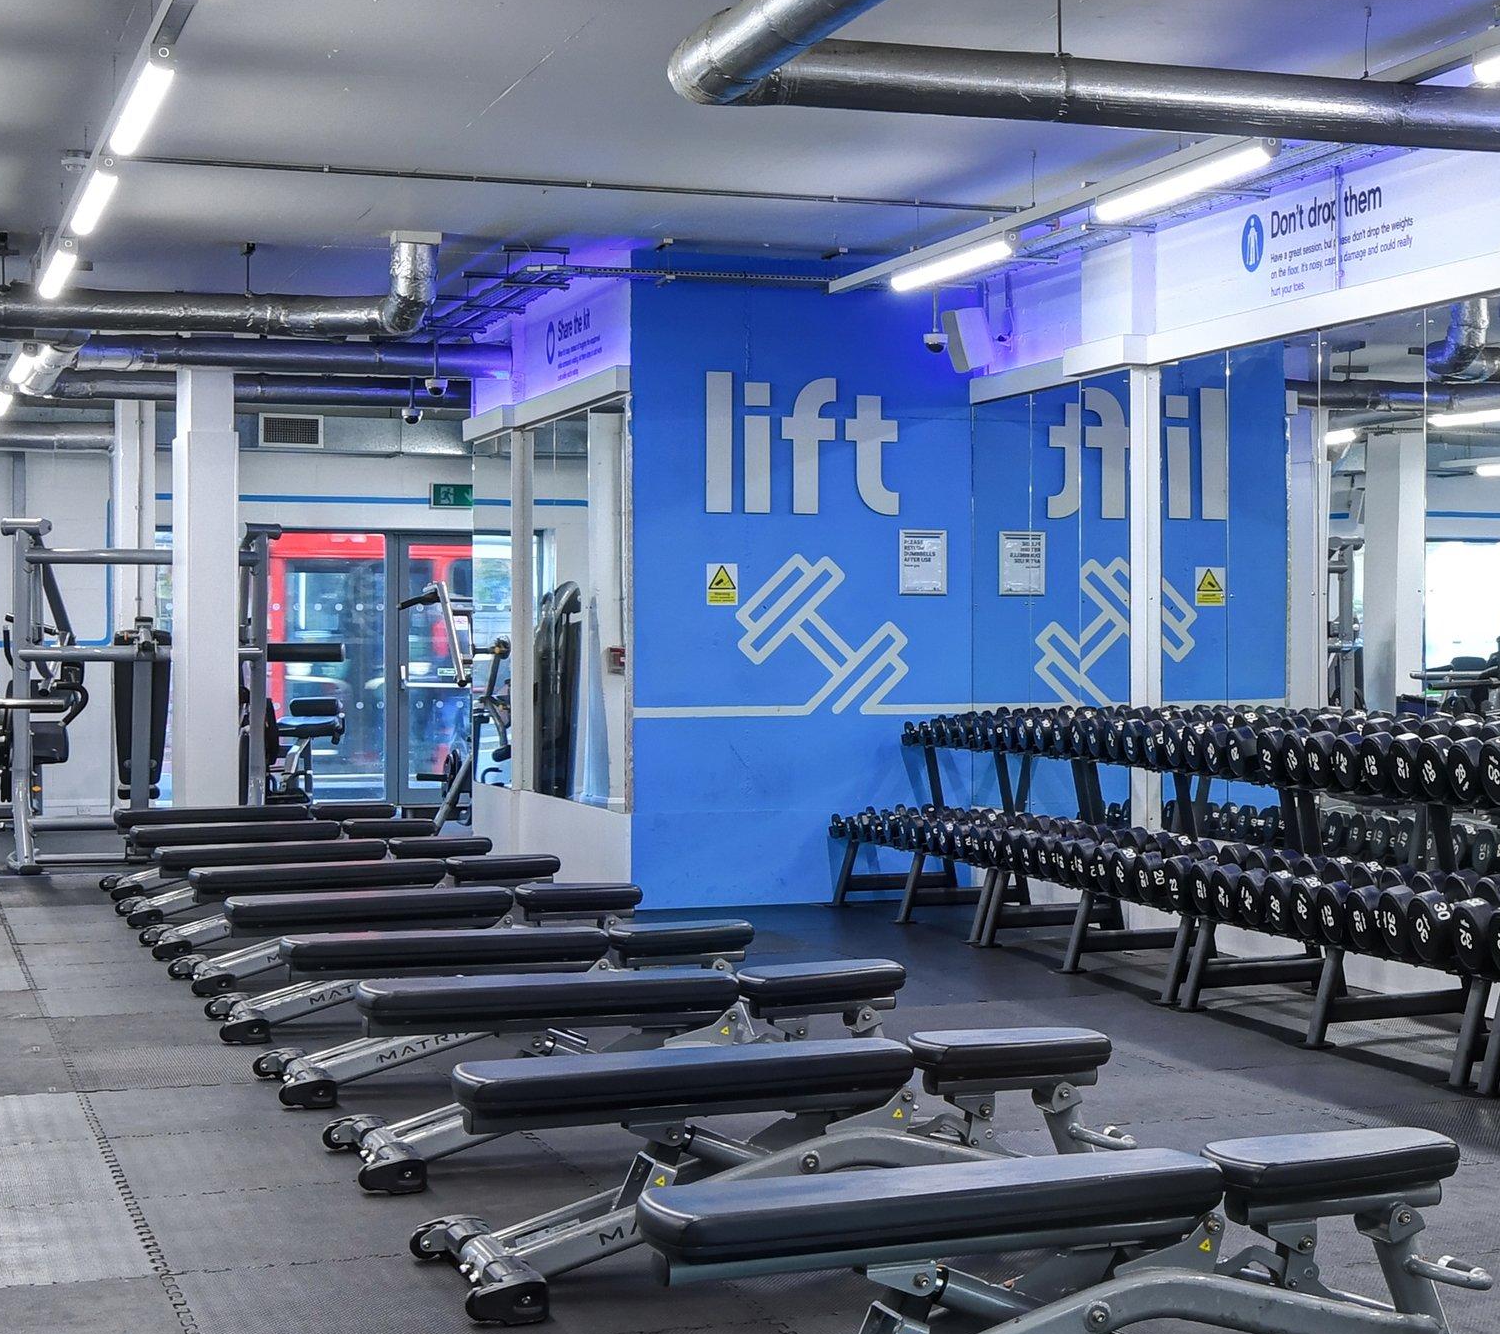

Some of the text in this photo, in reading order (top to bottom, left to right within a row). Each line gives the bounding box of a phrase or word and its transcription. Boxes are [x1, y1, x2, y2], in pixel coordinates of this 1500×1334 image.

[1271, 204, 1304, 239] Don't
[1344, 185, 1382, 218] them
[1288, 248, 1302, 262] great
[1367, 225, 1380, 239] drop
[1381, 223, 1390, 234] the
[1391, 217, 1414, 232] weights
[1343, 247, 1367, 261] damage
[1368, 244, 1379, 255] and
[1380, 238, 1396, 253] could
[1281, 284, 1292, 298] your
[705, 371, 899, 515] lift
[1424, 759, 1437, 783] 28
[1454, 764, 1467, 786] 28
[1487, 764, 1500, 786] 30
